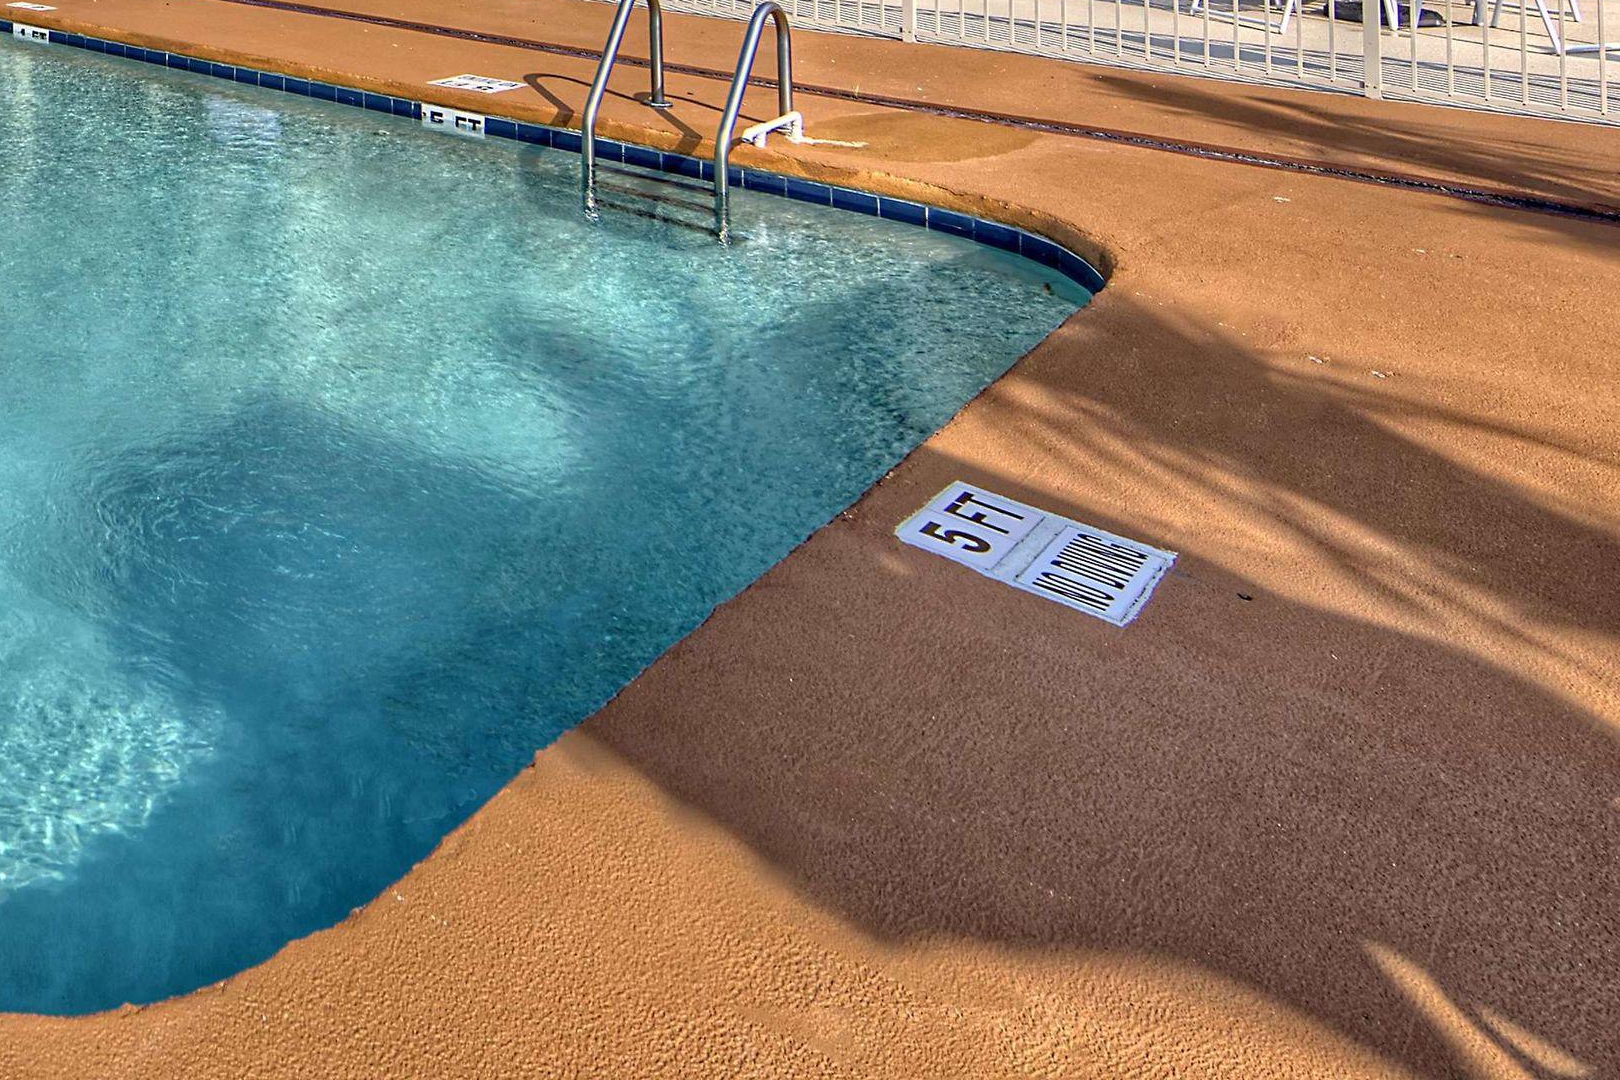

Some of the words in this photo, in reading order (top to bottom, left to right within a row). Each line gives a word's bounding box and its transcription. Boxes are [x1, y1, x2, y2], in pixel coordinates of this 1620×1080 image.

[943, 491, 1026, 536] FT
[918, 520, 992, 554] 5
[1050, 532, 1149, 591] DIVING
[1032, 571, 1116, 612] NO
